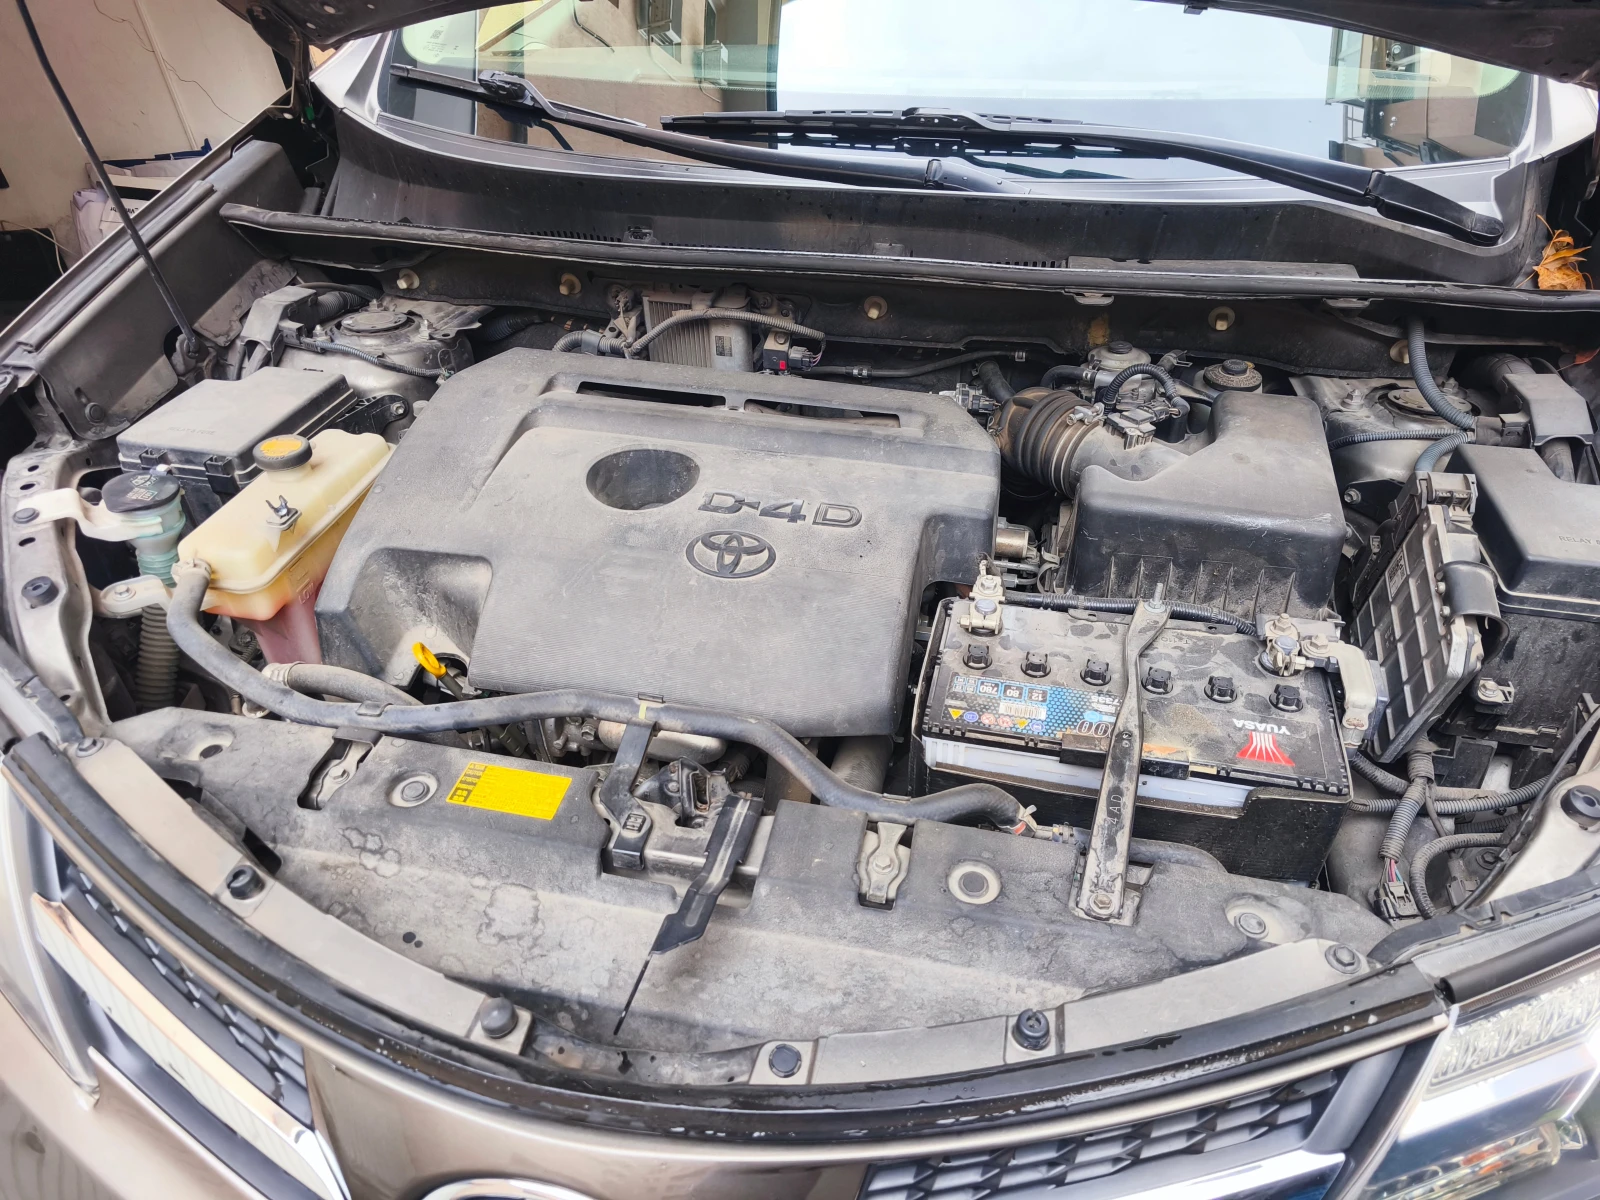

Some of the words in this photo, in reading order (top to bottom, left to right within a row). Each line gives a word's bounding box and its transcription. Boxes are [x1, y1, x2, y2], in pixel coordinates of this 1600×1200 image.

[1558, 535, 1592, 545] RELAY
[979, 685, 998, 695] 780
[1006, 688, 1020, 698] 80
[1031, 692, 1044, 702] 12
[1091, 695, 1122, 706] 7335
[1232, 718, 1291, 735] YUASA
[1107, 794, 1123, 825] 4AD
